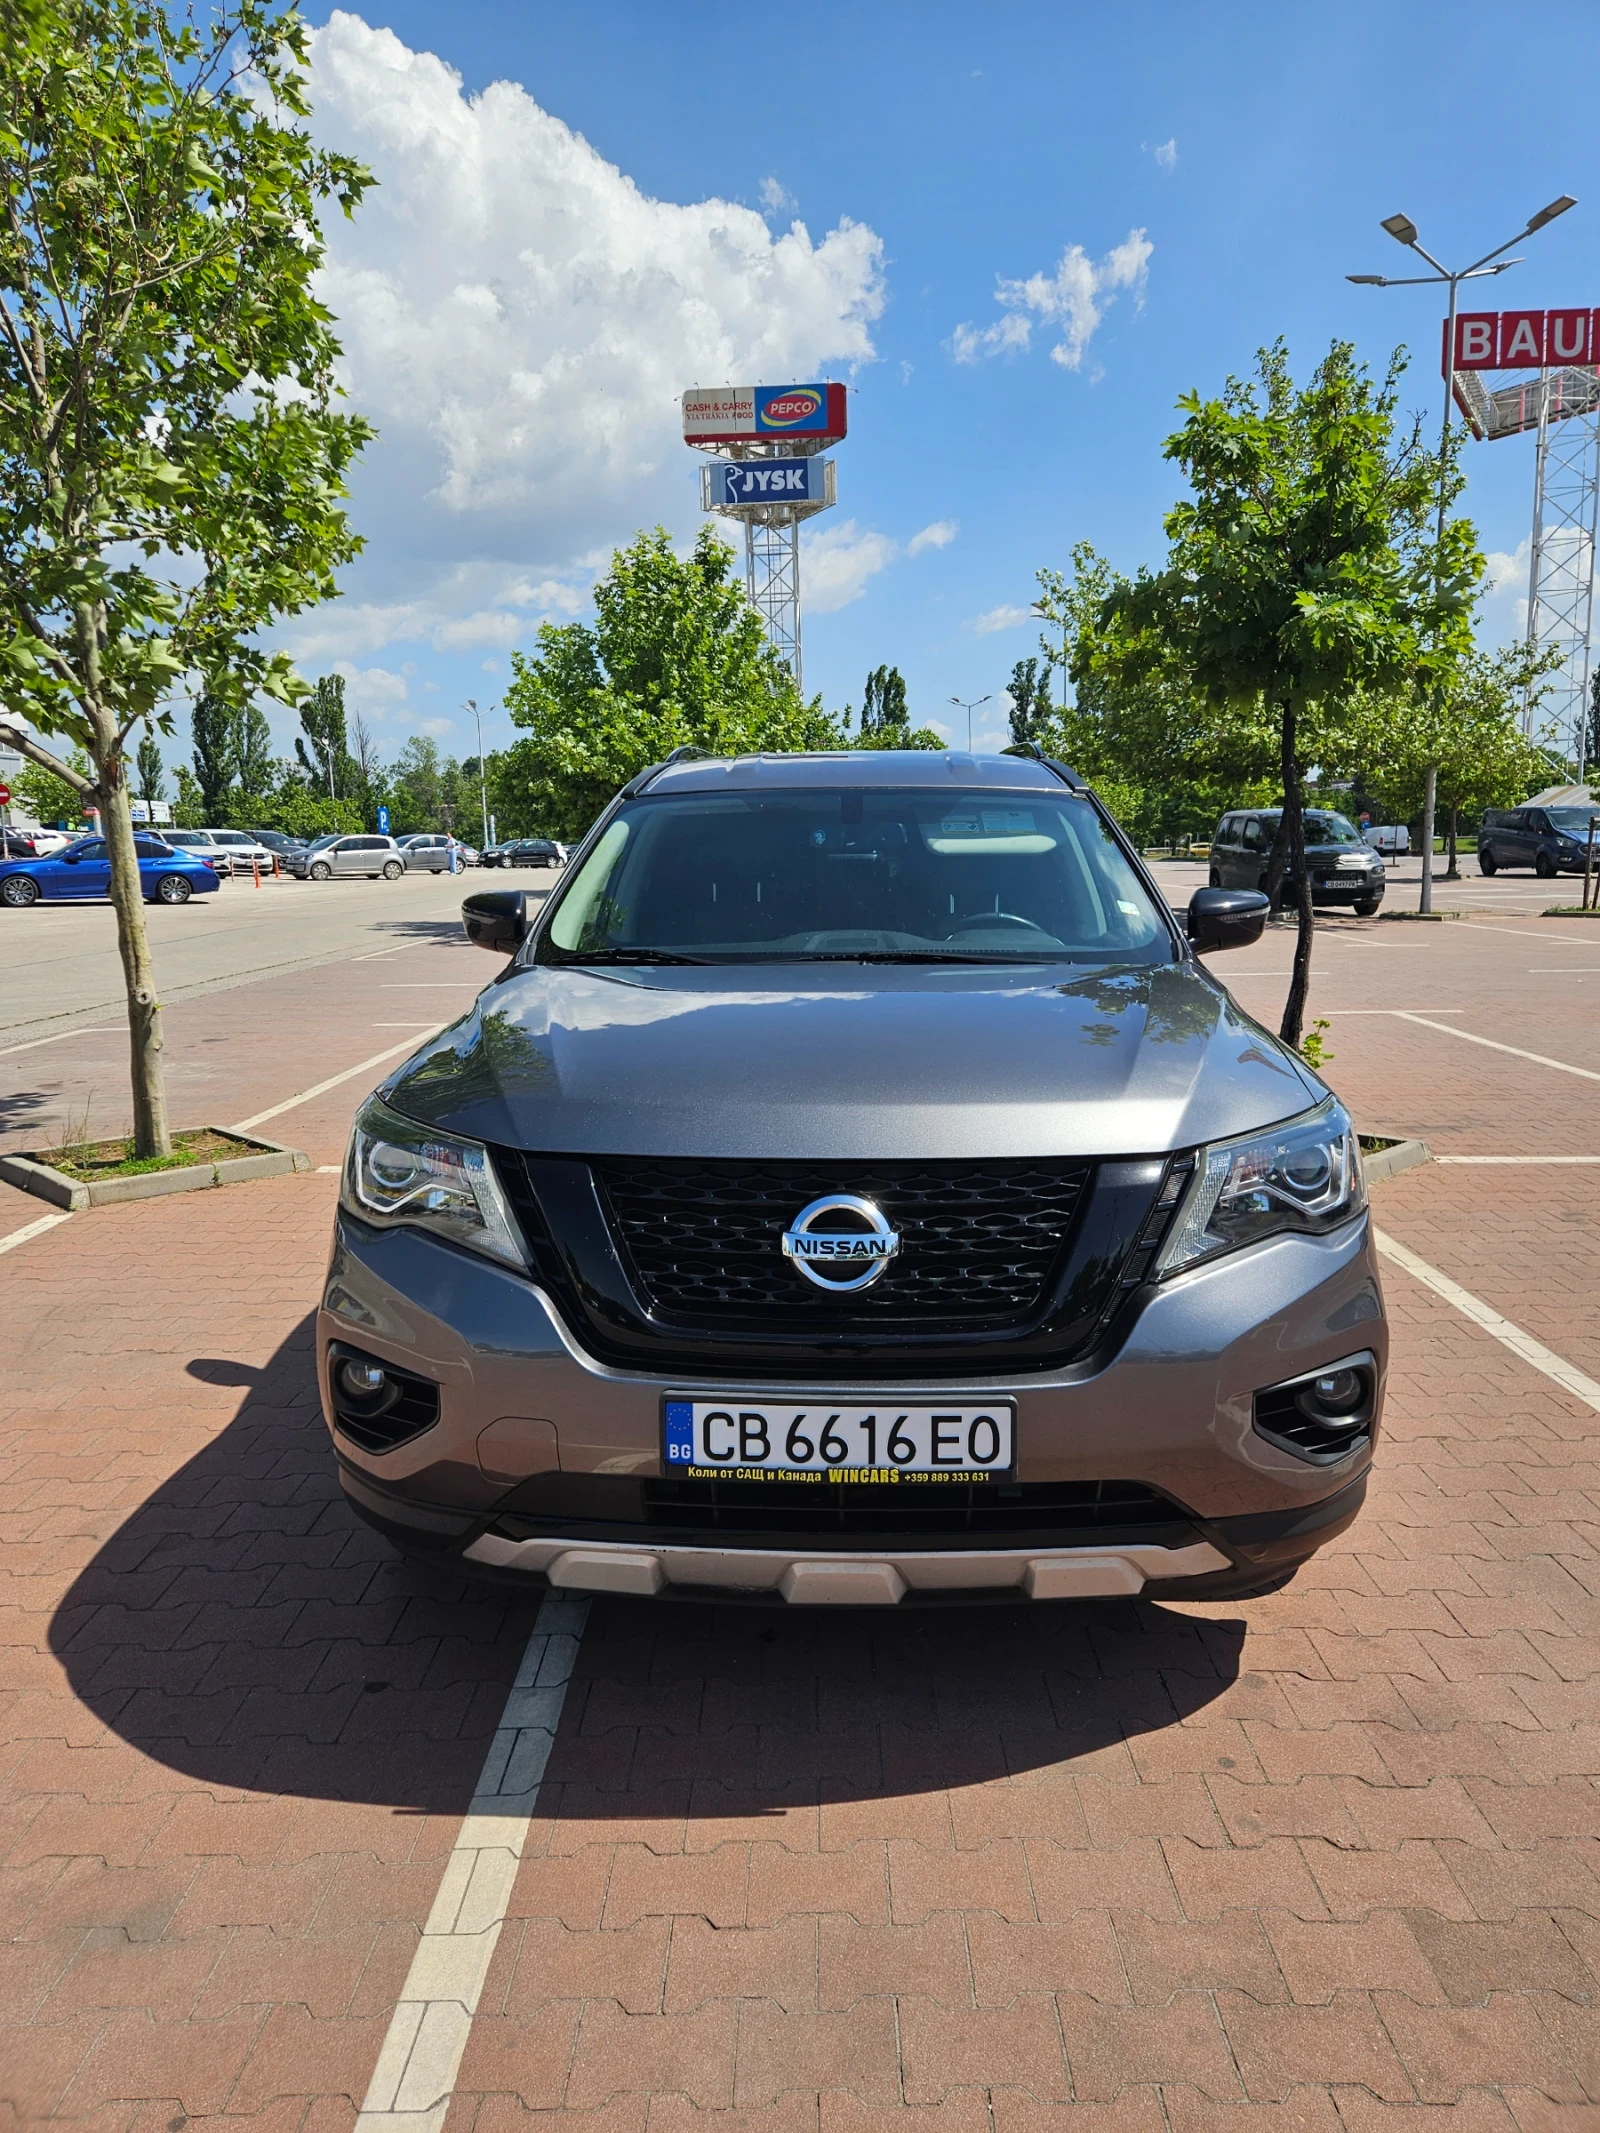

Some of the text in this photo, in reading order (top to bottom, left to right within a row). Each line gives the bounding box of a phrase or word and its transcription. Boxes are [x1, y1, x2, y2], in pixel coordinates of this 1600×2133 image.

[685, 401, 753, 412] CASH & CARRY
[770, 402, 813, 415] PEPCO
[700, 412, 729, 420] TRAKIA
[731, 411, 754, 419] FOOD
[741, 469, 805, 492] JYSK
[380, 811, 387, 829] P
[794, 1239, 886, 1255] NISSAN
[785, 1414, 917, 1465] 6616
[668, 1443, 692, 1460] BG
[688, 1466, 990, 1484] Коли от САЩ и Канада WINCARS +359 889 333 631
